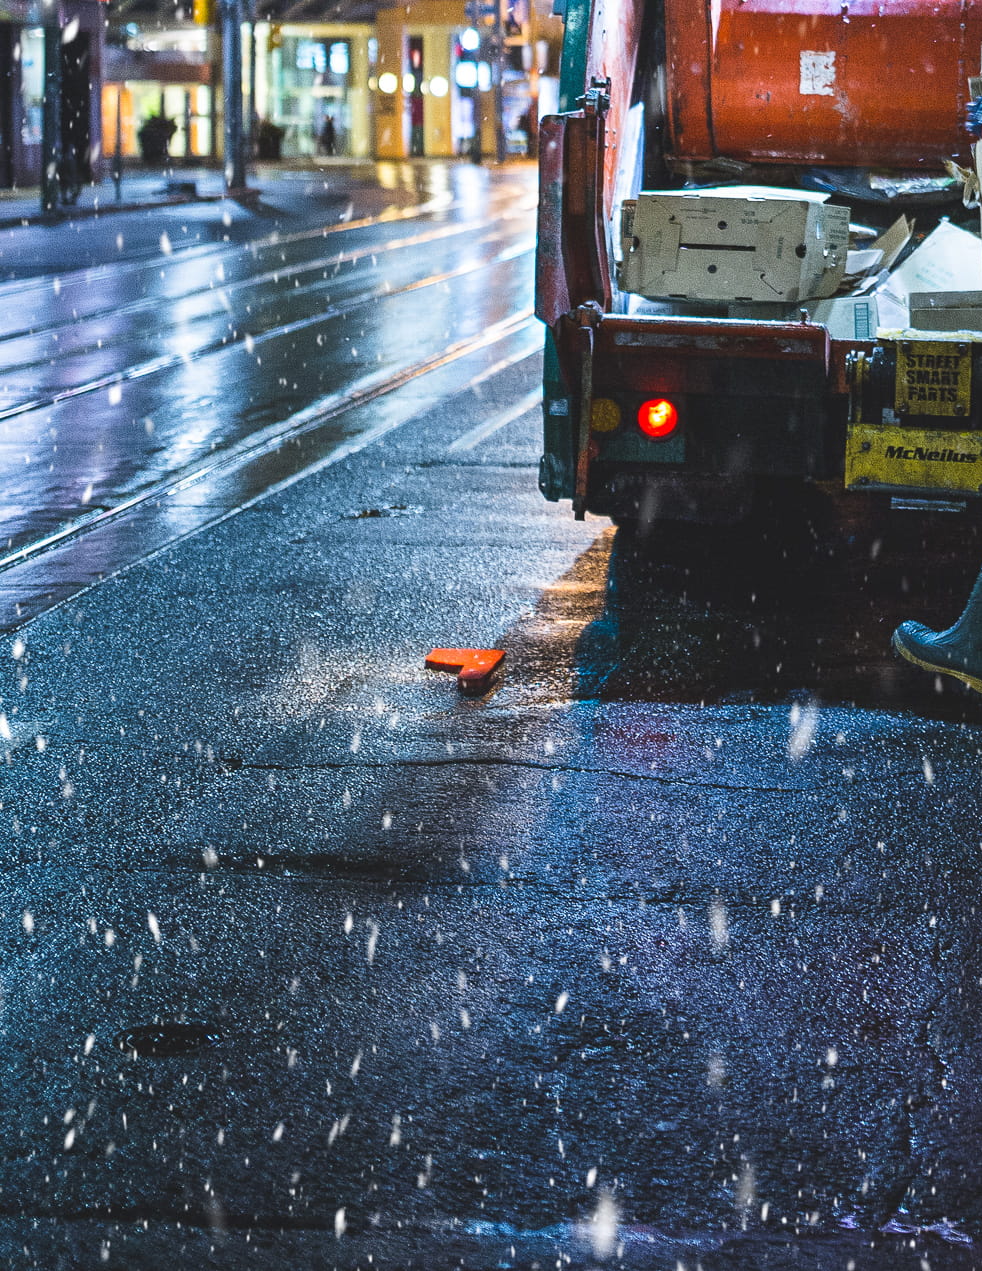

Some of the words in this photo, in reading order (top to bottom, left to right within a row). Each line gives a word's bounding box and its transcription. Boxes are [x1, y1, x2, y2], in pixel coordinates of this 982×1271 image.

[906, 355, 961, 370] STREET
[906, 370, 961, 385] SMART
[908, 386, 959, 402] PARTS
[884, 445, 979, 464] McNeilus
